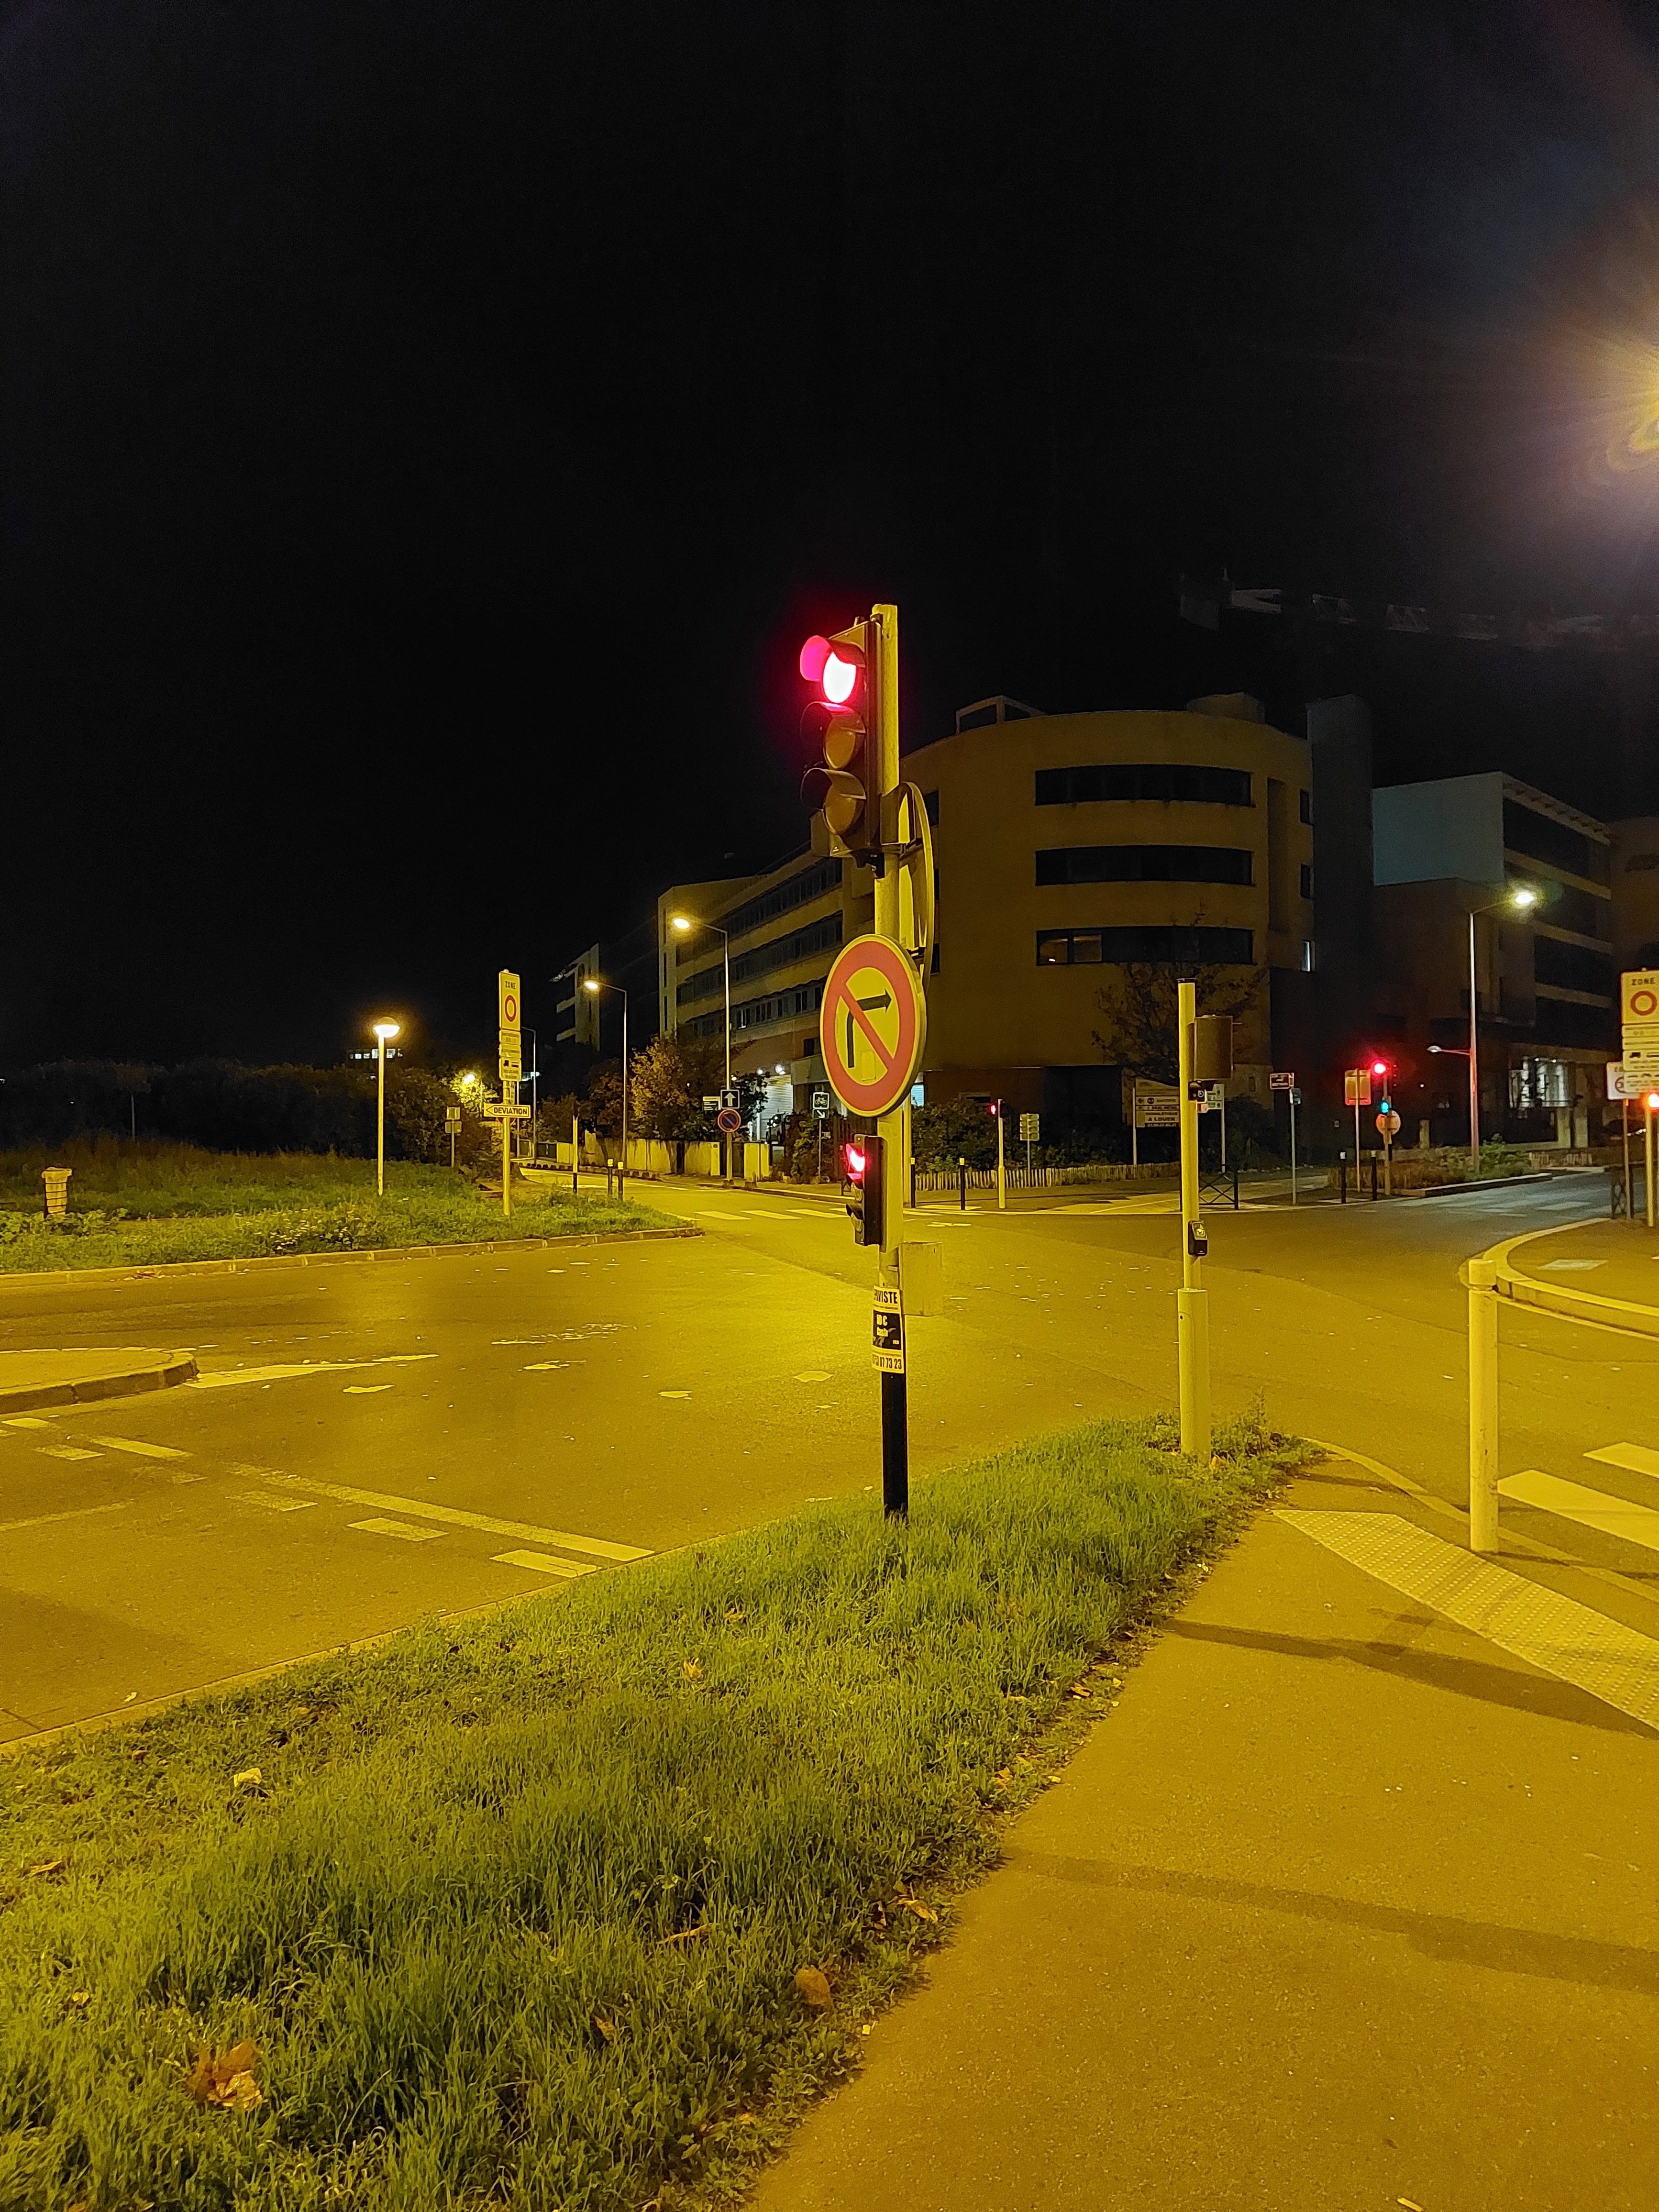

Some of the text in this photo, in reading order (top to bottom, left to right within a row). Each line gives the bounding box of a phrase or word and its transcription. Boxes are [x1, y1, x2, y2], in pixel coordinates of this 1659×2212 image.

[505, 980, 516, 990] ZONE
[1631, 977, 1655, 986] ZONE
[494, 1106, 527, 1115] DEVIATION
[885, 1357, 893, 1369] 73
[894, 1358, 902, 1370] 23
